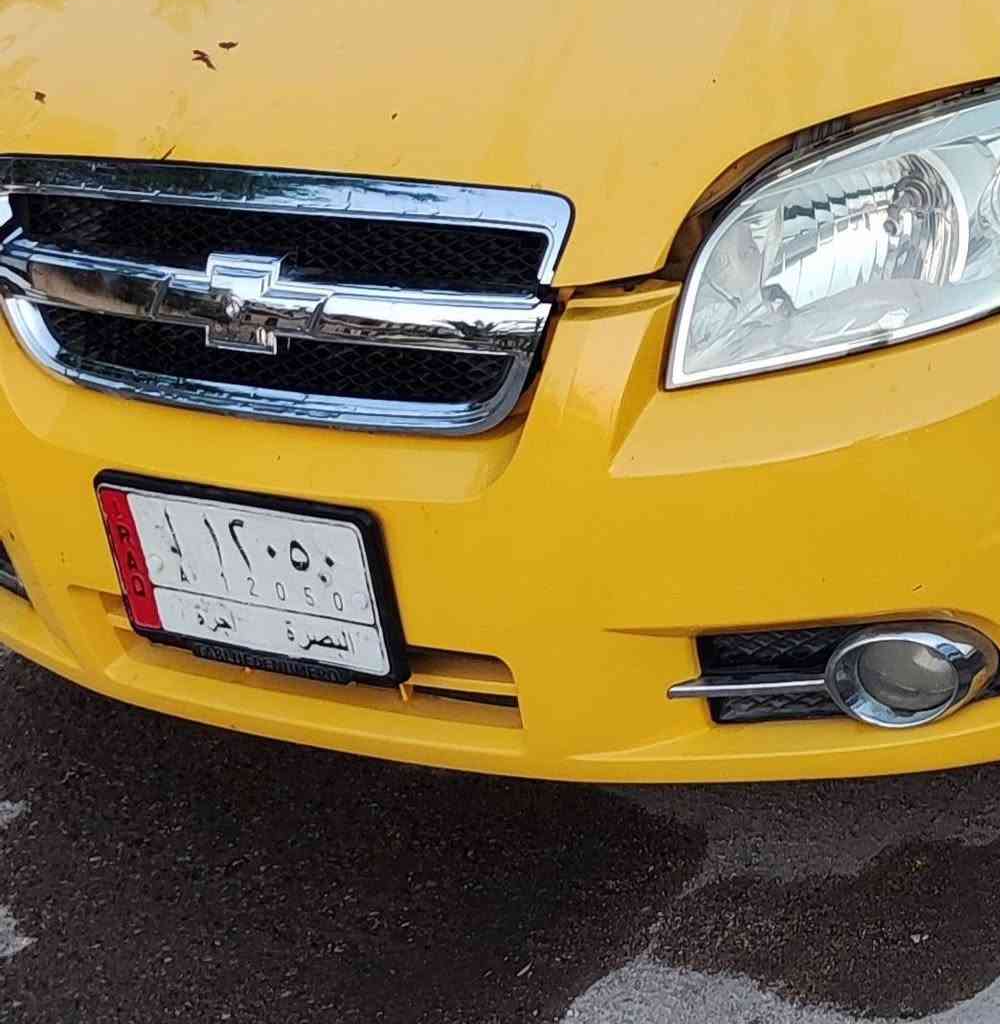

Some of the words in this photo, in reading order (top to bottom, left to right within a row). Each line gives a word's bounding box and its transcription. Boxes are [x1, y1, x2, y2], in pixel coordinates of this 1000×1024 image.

[111, 495, 147, 598] IRAQ
[203, 516, 336, 573] ١٢٠٥٠
[220, 571, 344, 612] 12050
[285, 620, 355, 659] البصرة
